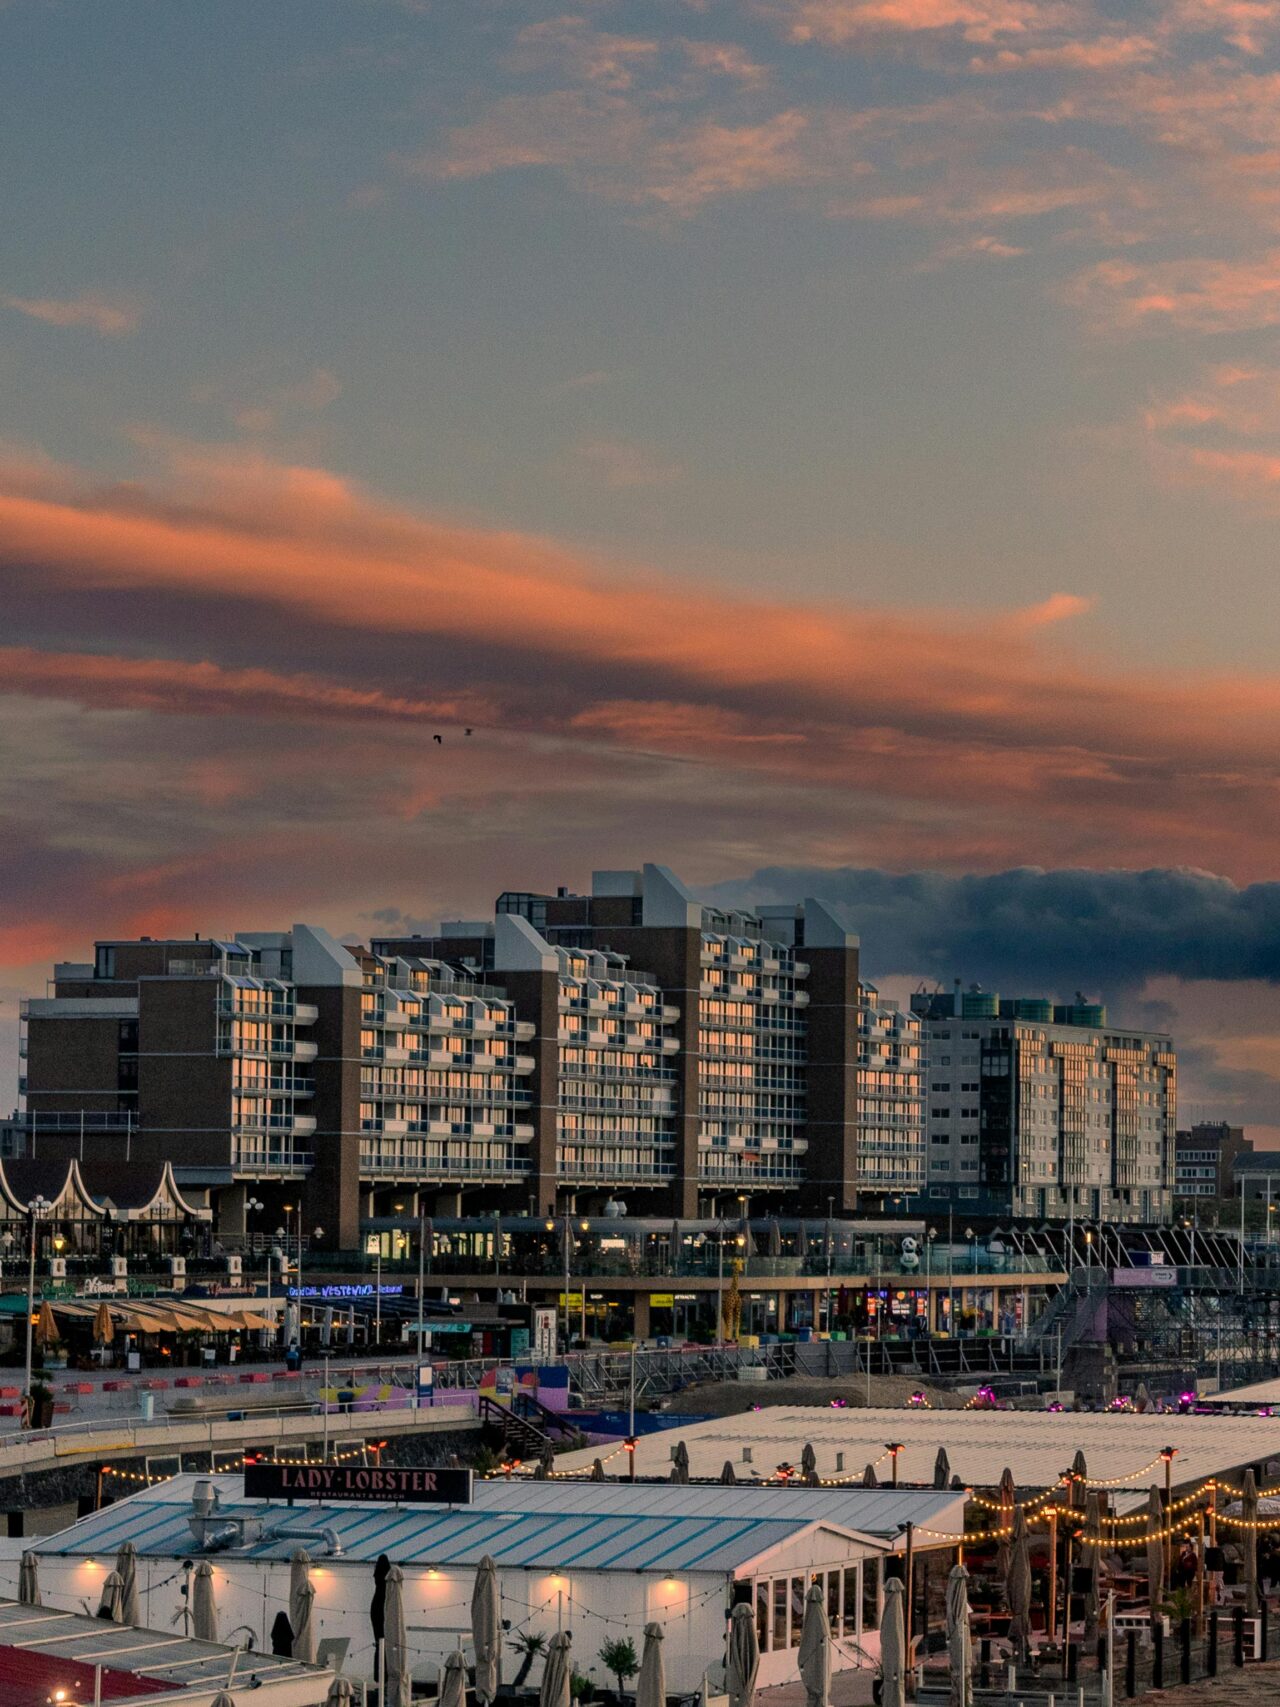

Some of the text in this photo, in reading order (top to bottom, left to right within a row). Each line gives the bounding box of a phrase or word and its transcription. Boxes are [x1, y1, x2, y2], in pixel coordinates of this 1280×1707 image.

[282, 1468, 437, 1490] LADY LOBSTER
[310, 1490, 366, 1498] RESTAURANT
